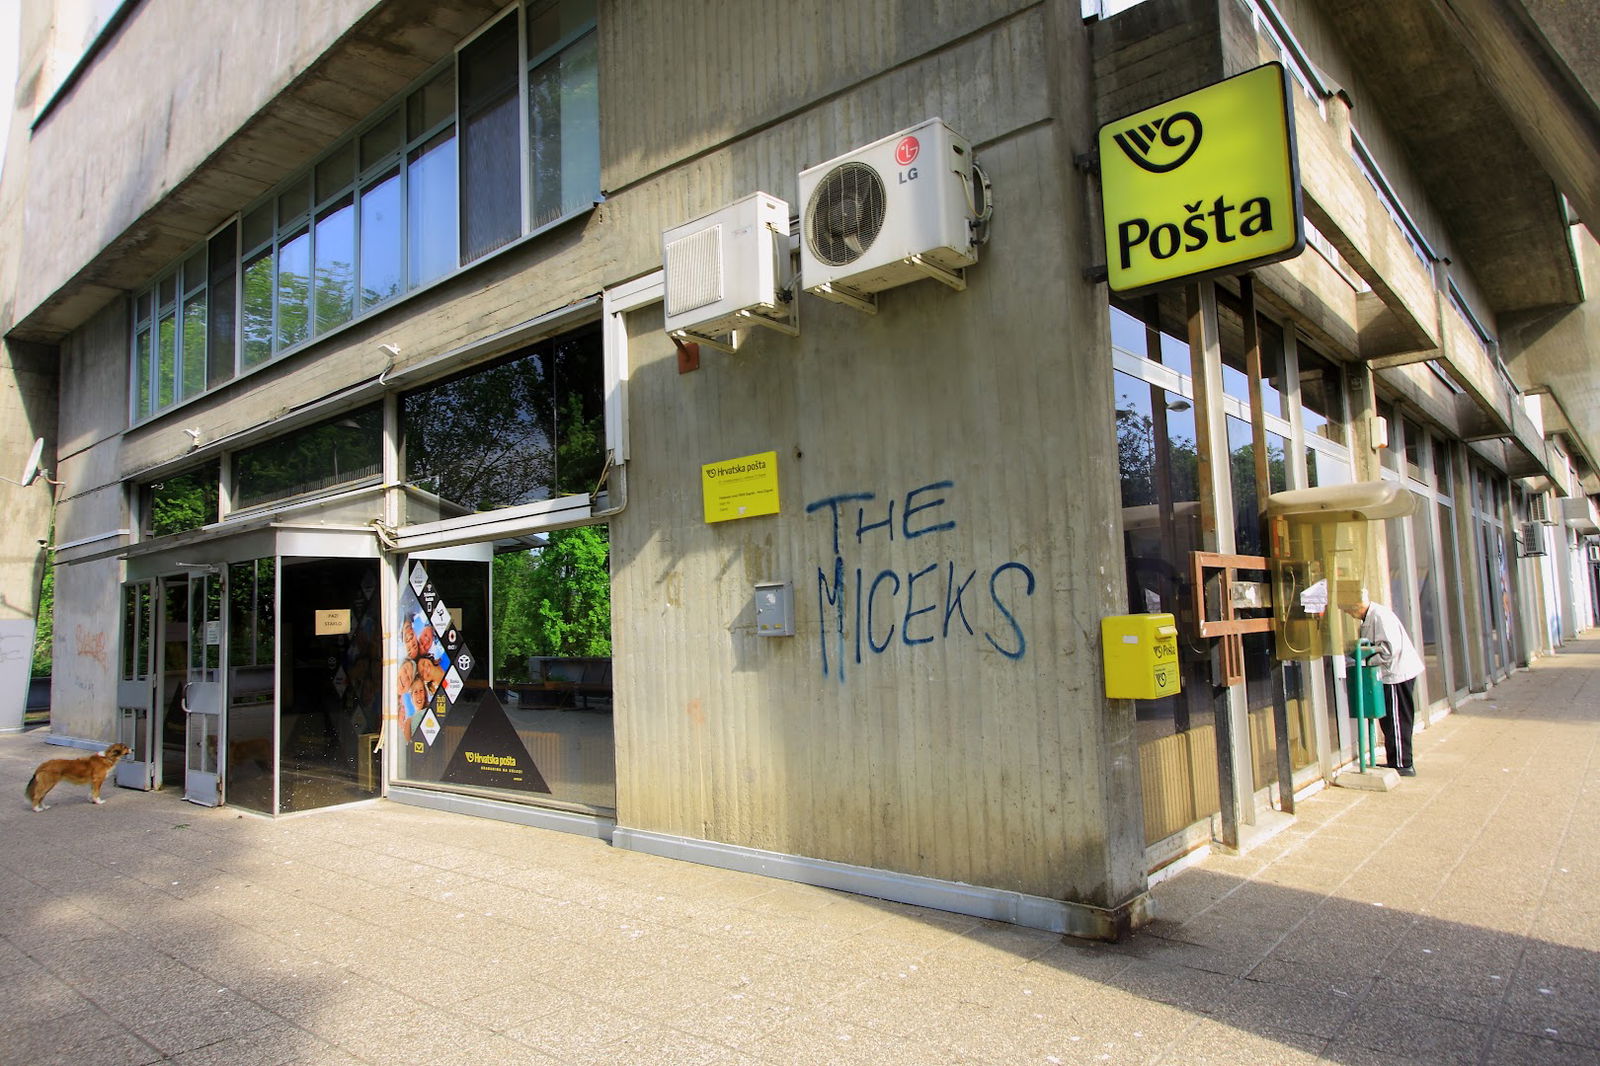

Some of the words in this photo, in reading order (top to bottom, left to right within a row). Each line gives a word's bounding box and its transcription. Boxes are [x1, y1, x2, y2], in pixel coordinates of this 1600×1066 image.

[899, 167, 919, 184] LG
[1118, 195, 1273, 270] Pošta
[717, 464, 746, 477] Hrvatska
[747, 461, 766, 473] pošta
[806, 480, 956, 554] THE
[474, 753, 499, 765] Hrvatska
[500, 756, 516, 766] pošta
